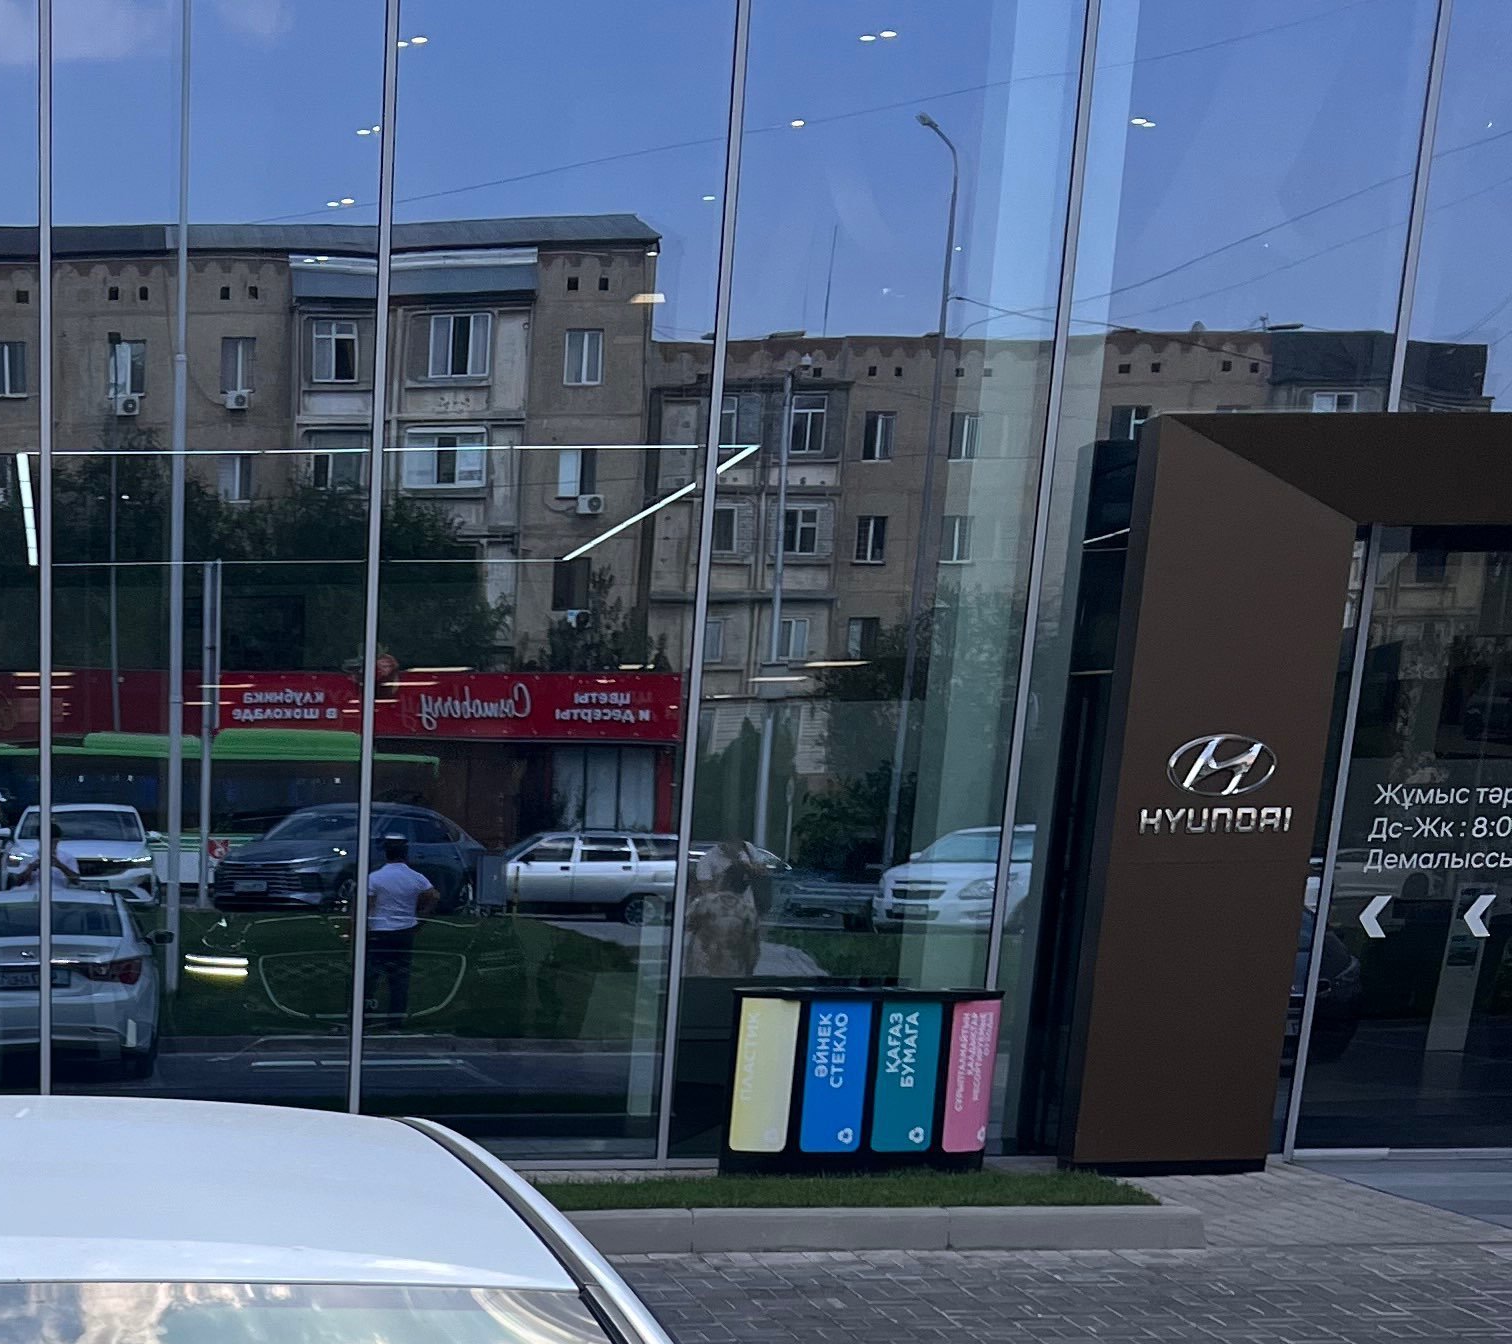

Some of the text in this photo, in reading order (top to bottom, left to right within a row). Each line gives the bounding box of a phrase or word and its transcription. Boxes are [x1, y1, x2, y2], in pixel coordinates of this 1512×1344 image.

[1139, 806, 1293, 834] HYUNDAI
[1374, 783, 1471, 810] Жұмыс
[829, 1012, 849, 1089] СТЕКЛО
[899, 1011, 921, 1088] БУМАГА
